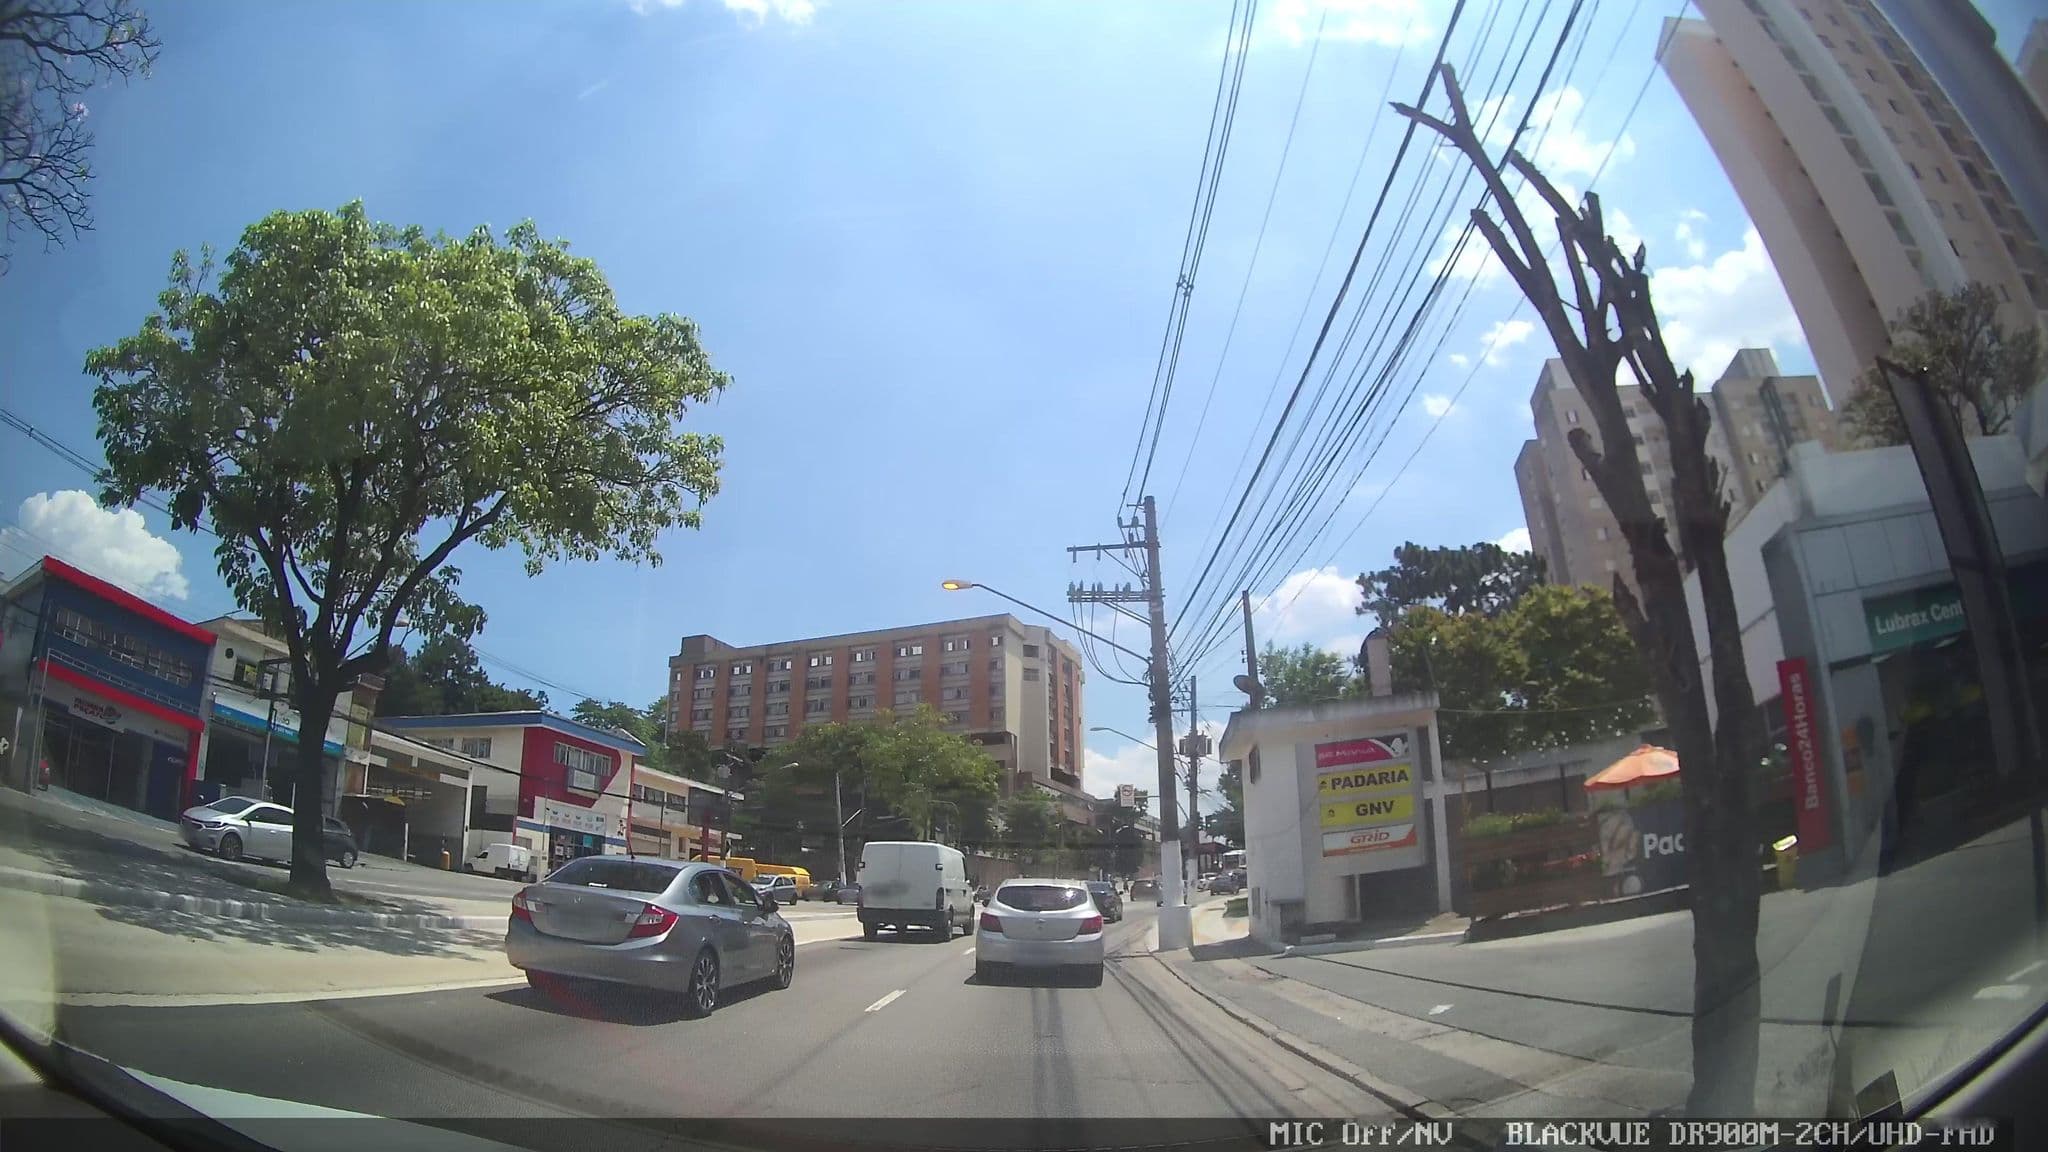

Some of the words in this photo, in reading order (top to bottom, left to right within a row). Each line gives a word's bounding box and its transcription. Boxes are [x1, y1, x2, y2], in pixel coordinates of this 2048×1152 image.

[1875, 611, 1930, 635] Lubrax
[1790, 673, 1819, 810] Banco24Horas
[1331, 769, 1408, 790] PADARIA
[1356, 800, 1394, 816] GNV
